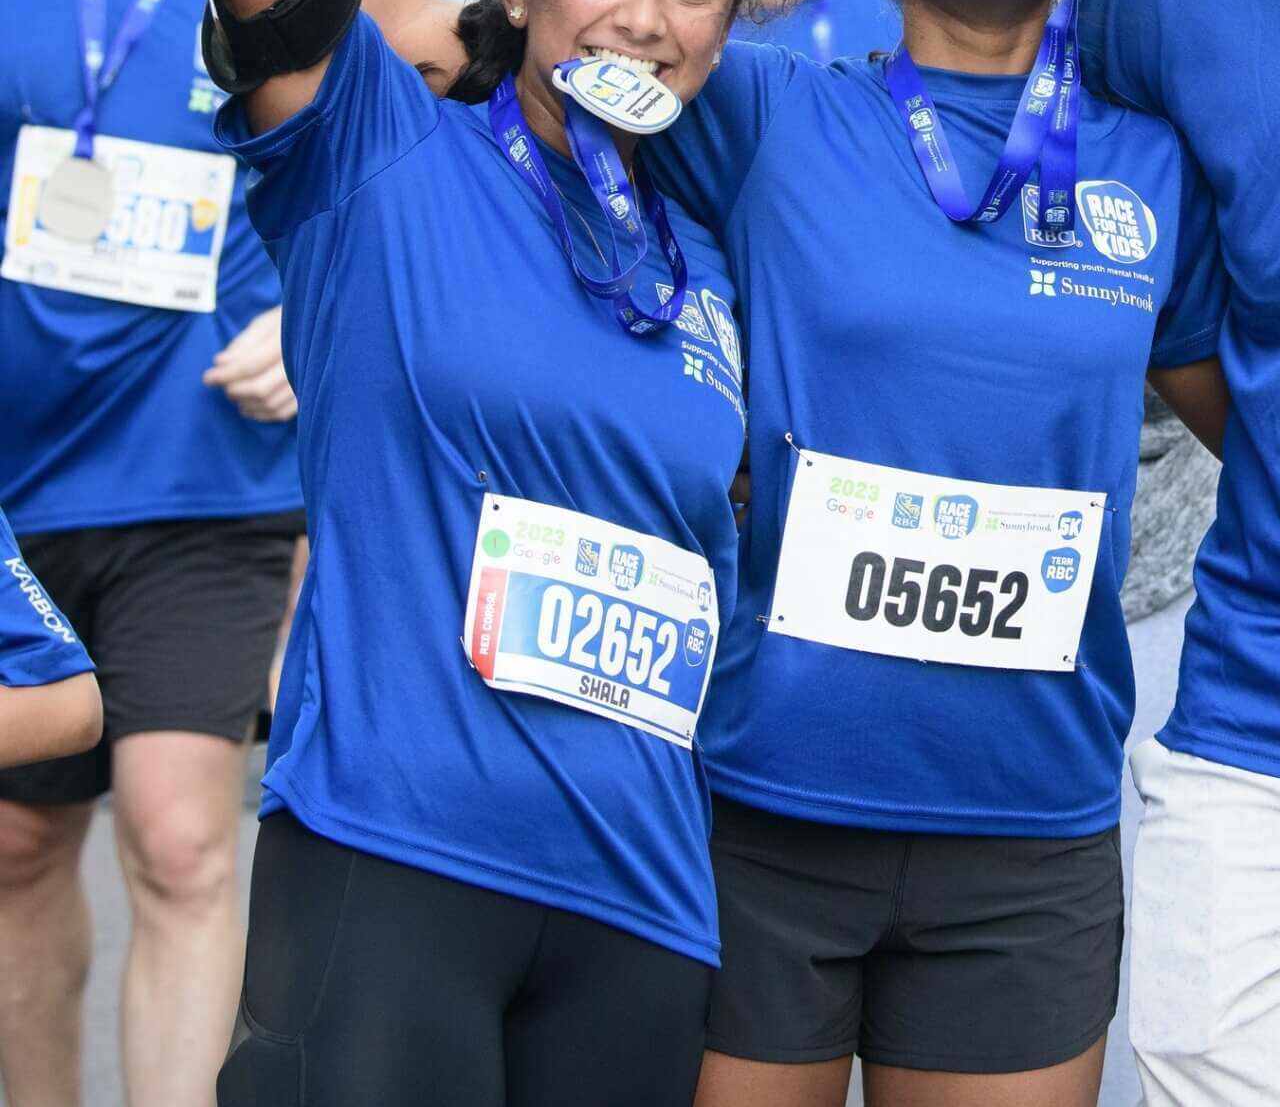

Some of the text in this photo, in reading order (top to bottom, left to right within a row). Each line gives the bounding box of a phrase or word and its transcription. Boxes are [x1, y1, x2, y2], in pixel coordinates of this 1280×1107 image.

[1086, 194, 1137, 225] RACE
[1030, 228, 1069, 244] RBC
[1093, 217, 1141, 239] FOR THE
[1094, 231, 1147, 260] KIDS
[1030, 256, 1080, 271] Supporting
[1081, 263, 1106, 273] youth
[1061, 276, 1153, 313] Sunnybrook
[829, 476, 881, 503] 2023
[938, 500, 972, 518] RACE
[894, 516, 917, 529] RBC
[936, 521, 968, 539] KIDS
[937, 514, 970, 527] FOR THE
[1059, 516, 1083, 538] 5K
[515, 520, 566, 547] 2023
[612, 548, 640, 568] RACE
[577, 561, 596, 577] RBC
[611, 563, 626, 576] FOR
[1046, 565, 1076, 581] RBC
[612, 571, 637, 591] KIDS
[4, 556, 77, 644] KARBON
[844, 551, 1030, 640] 05652
[479, 590, 498, 656] RED CORRAL
[537, 584, 679, 697] 02652
[686, 636, 705, 655] RBC
[578, 675, 631, 710] SHALA
